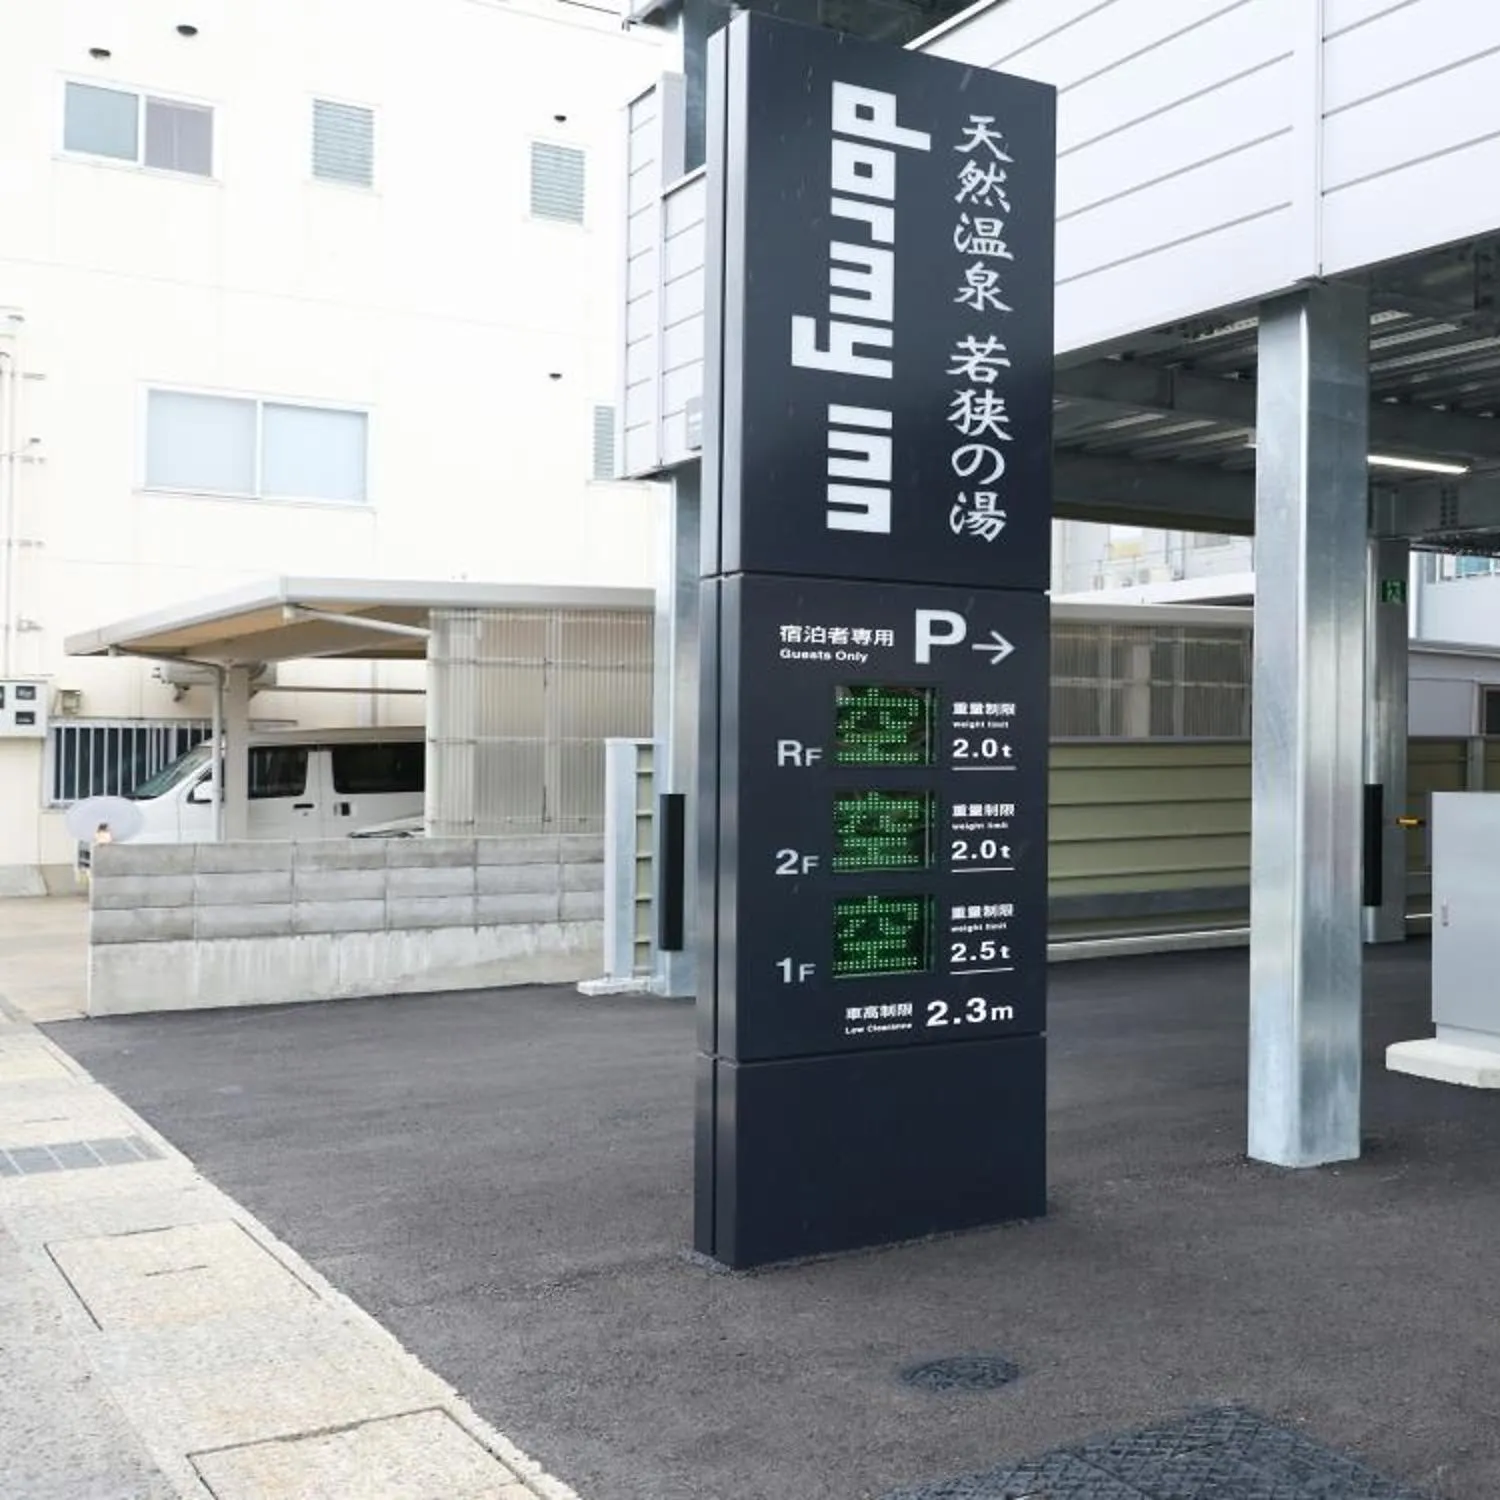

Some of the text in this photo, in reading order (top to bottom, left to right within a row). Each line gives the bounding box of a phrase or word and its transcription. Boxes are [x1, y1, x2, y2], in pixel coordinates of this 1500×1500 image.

[791, 80, 931, 535] dormy inn
[946, 115, 1015, 543] 天然温泉 若狭の湯
[779, 625, 895, 647] 宿泊者専用
[915, 609, 968, 664] P
[779, 648, 869, 664] Guests Only
[952, 702, 1016, 717] 重量制限
[837, 688, 919, 761] 空
[776, 740, 822, 767] RF
[951, 804, 1015, 818] 重量制限
[833, 792, 919, 865] 空
[775, 848, 820, 876] 2F
[833, 895, 918, 971] 空
[776, 957, 817, 984] 1F
